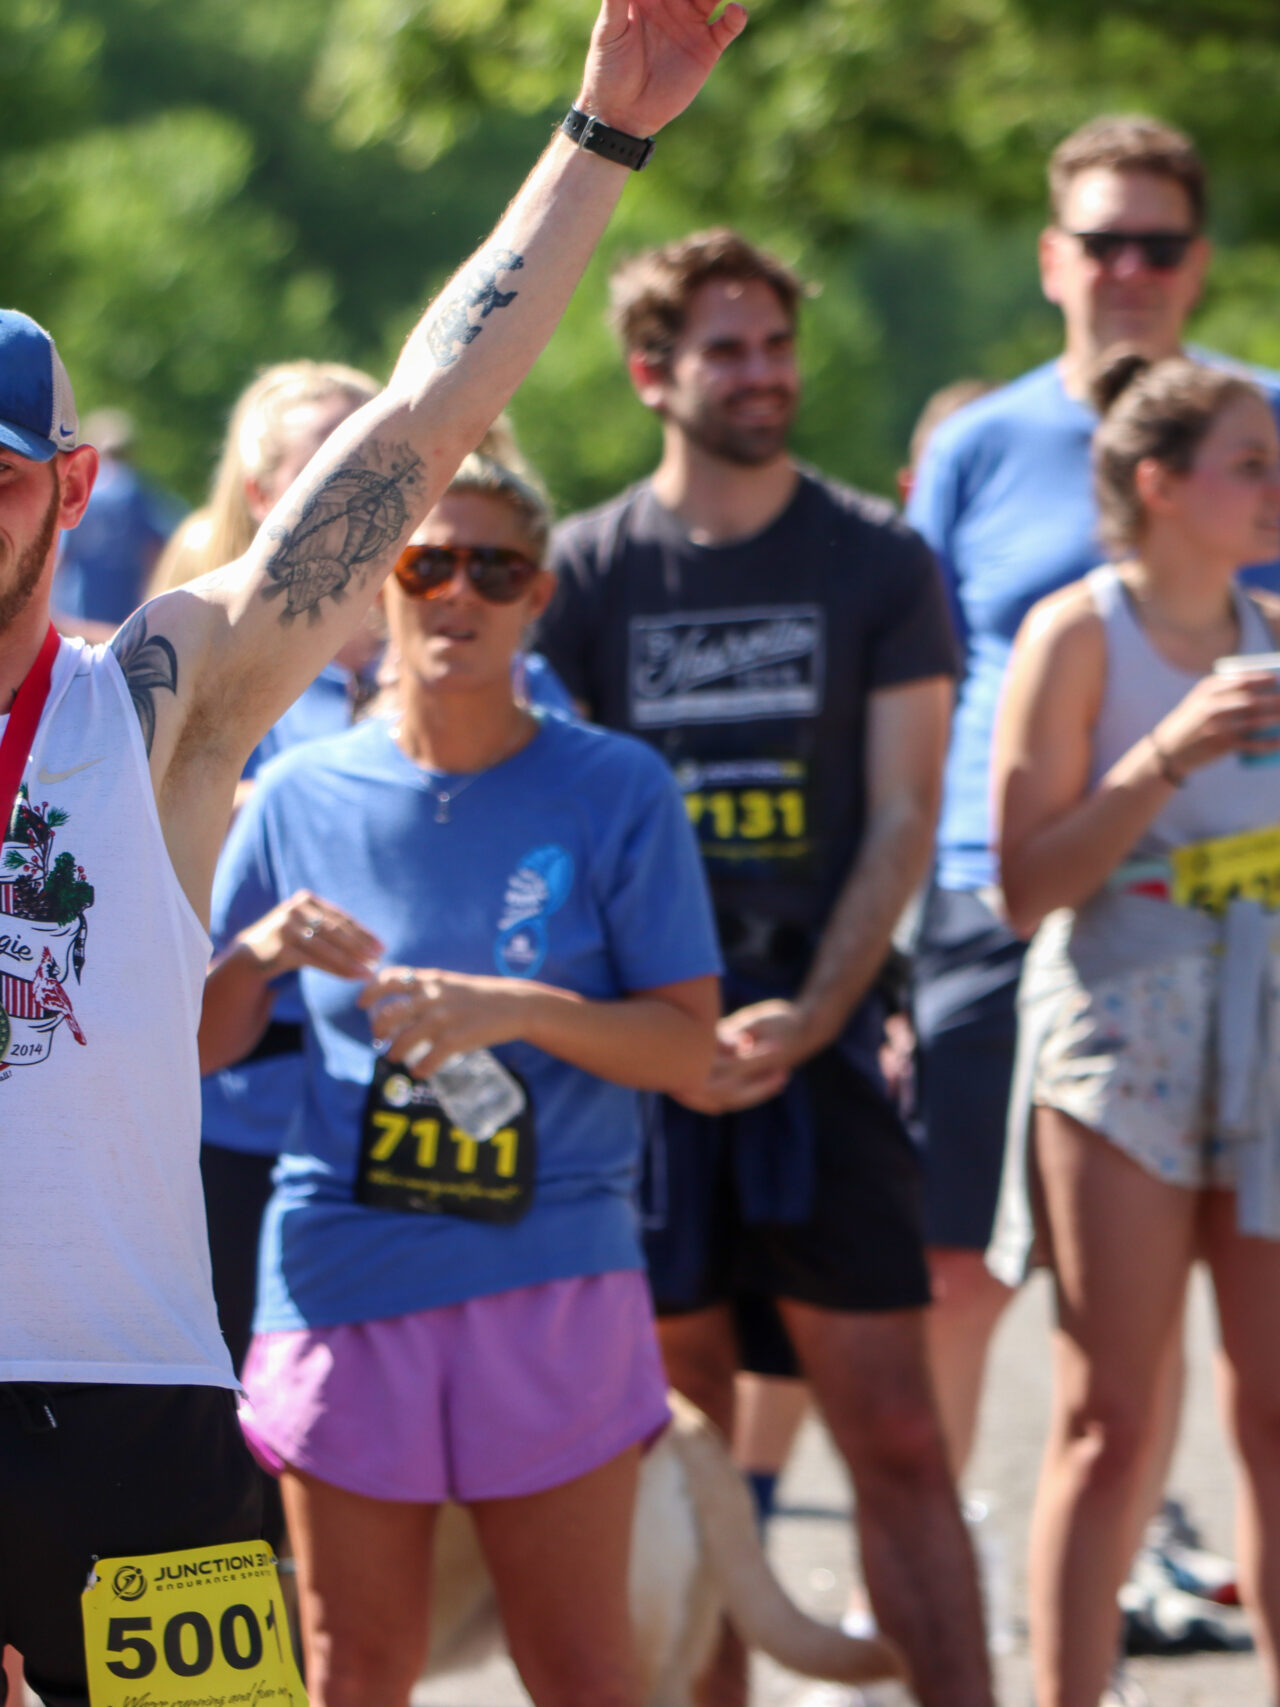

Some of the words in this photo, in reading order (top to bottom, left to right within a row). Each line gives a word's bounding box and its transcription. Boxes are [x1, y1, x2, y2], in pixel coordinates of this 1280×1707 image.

[10, 1043, 43, 1056] 2014
[370, 1110, 518, 1178] 7111
[154, 1554, 255, 1582] JUNCTION
[105, 1599, 284, 1680] 5001
